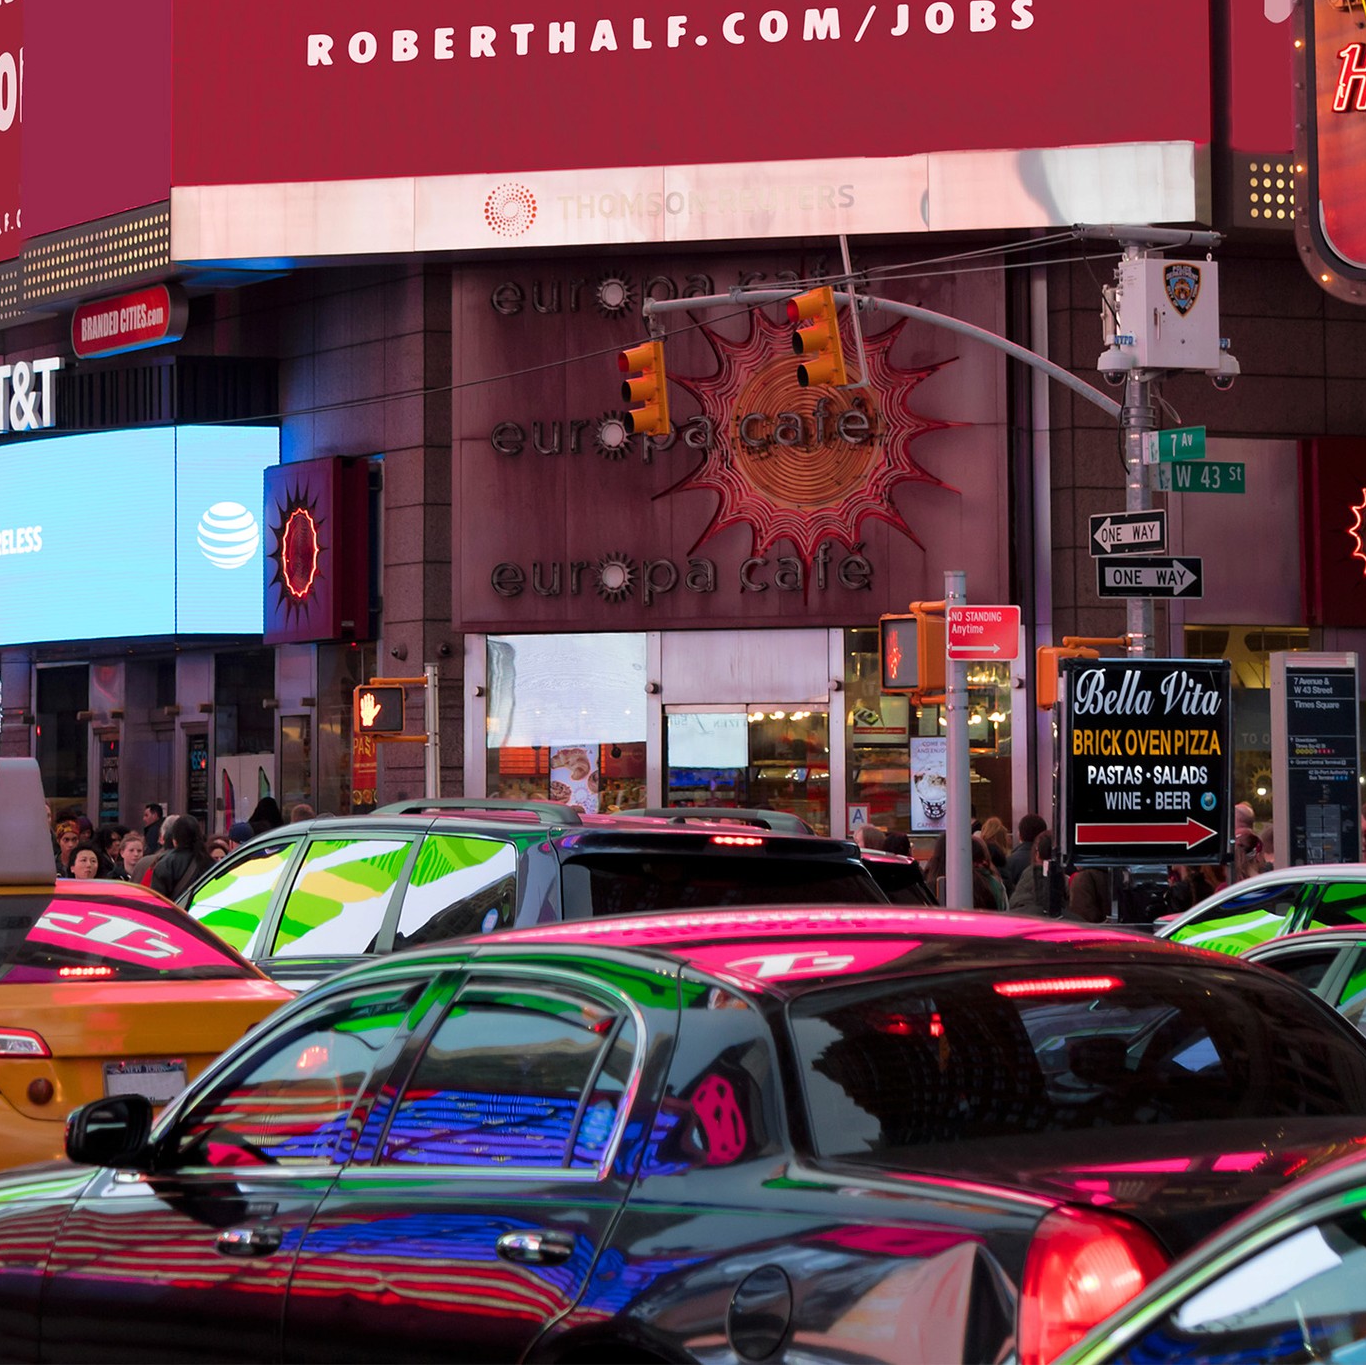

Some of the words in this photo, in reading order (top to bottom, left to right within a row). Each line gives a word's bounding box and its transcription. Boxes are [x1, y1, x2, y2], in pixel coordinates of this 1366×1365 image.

[556, 190, 706, 220] THOMSON
[716, 183, 855, 214] REUTERS
[80, 311, 121, 343] BRANDED
[119, 302, 164, 335] CITIES.com
[1115, 335, 1134, 345] NYPD
[738, 396, 872, 449] café
[1170, 434, 1178, 458] 7
[1182, 432, 1194, 447] Av
[1176, 464, 1191, 488] W
[1200, 465, 1221, 489] 43
[1228, 466, 1242, 482] St
[1101, 526, 1123, 544] ONE
[1132, 523, 1156, 540] WAY
[739, 541, 873, 593] café
[1113, 569, 1143, 585] ONE
[1156, 569, 1187, 585] WAY
[950, 611, 964, 623] NO
[965, 610, 1002, 622] STANDING
[951, 622, 985, 637] Anytime
[1293, 677, 1299, 686] 7
[1298, 677, 1324, 686] Avenue
[1293, 686, 1302, 694] W
[1303, 686, 1312, 694] 43
[1312, 686, 1333, 695] Street
[1074, 668, 1155, 717] Bella
[1160, 670, 1223, 717] Vita
[1294, 701, 1315, 709] Times
[1315, 701, 1340, 711] Square
[1072, 729, 1123, 757] BRICK
[1124, 729, 1172, 757] OVEN
[1174, 729, 1222, 756] PIZZA
[1087, 765, 1143, 785] PASTAS
[1153, 765, 1209, 785] SALADS
[1104, 791, 1142, 811] WINE
[1155, 791, 1191, 810] BEER
